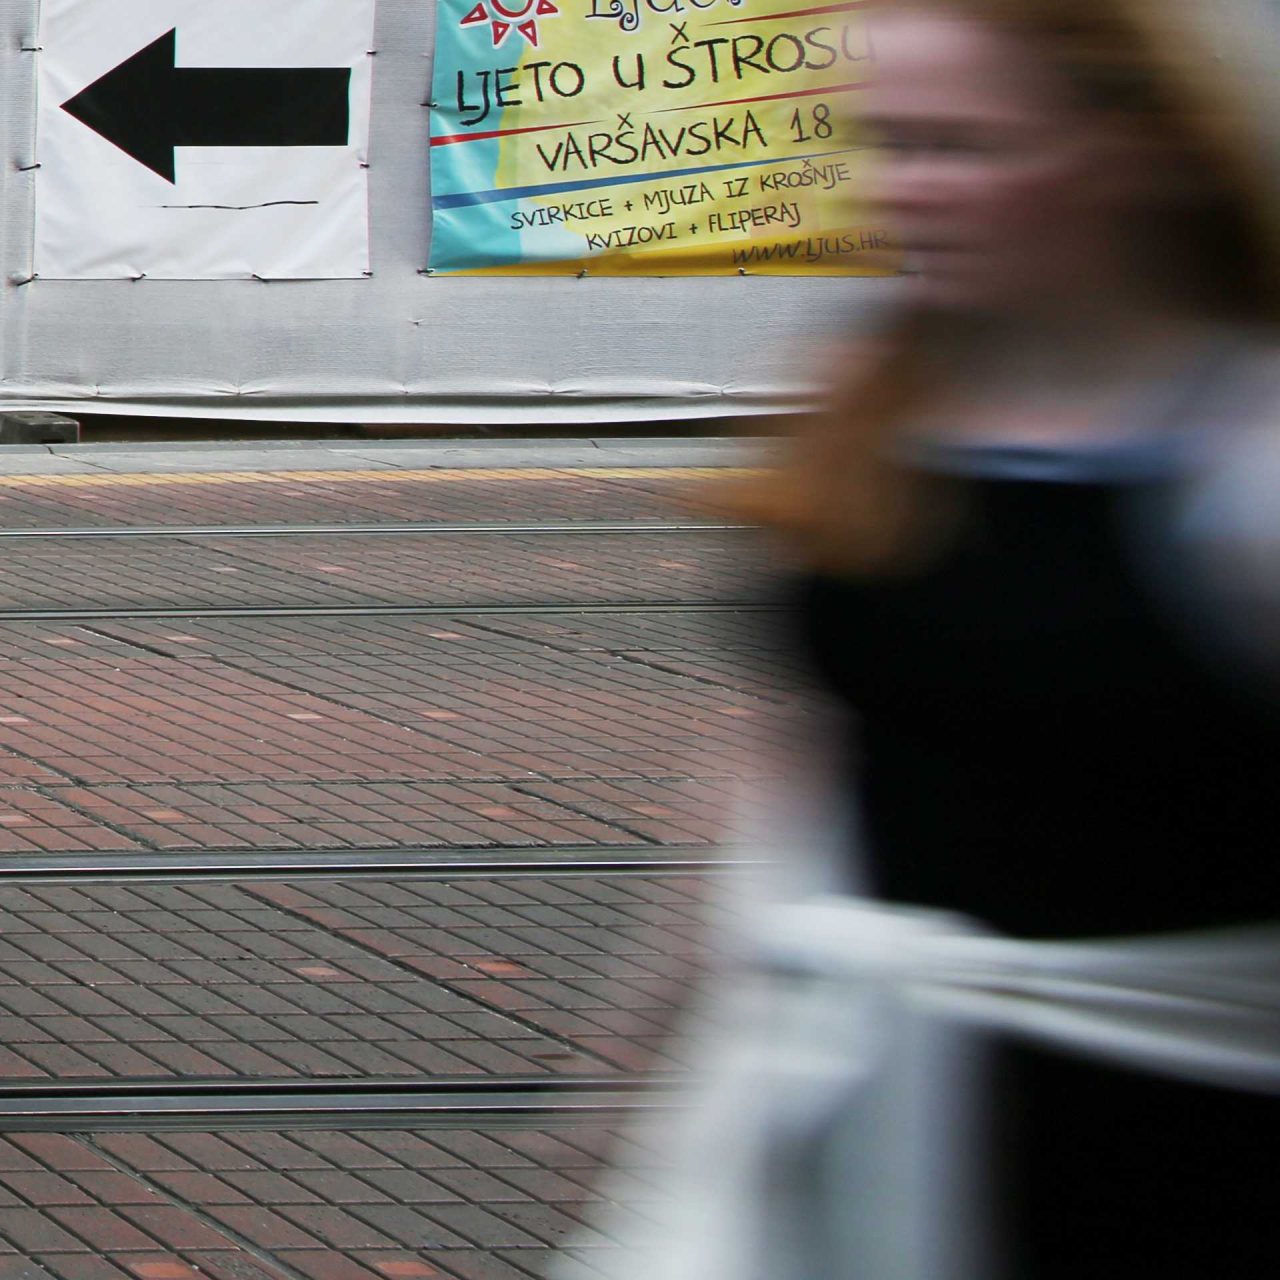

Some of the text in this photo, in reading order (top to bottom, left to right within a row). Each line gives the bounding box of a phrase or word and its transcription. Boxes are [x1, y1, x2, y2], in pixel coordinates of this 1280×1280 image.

[456, 61, 585, 126] LJETO
[536, 103, 833, 171] VARŠAVSKA 18
[510, 198, 614, 230] SVIRKICE
[643, 182, 715, 215] MJUZA
[723, 176, 750, 199] IZ
[760, 158, 853, 191] KROŠNJE
[585, 222, 678, 251] KVIZOVI
[706, 201, 802, 233] FLIPERAJ
